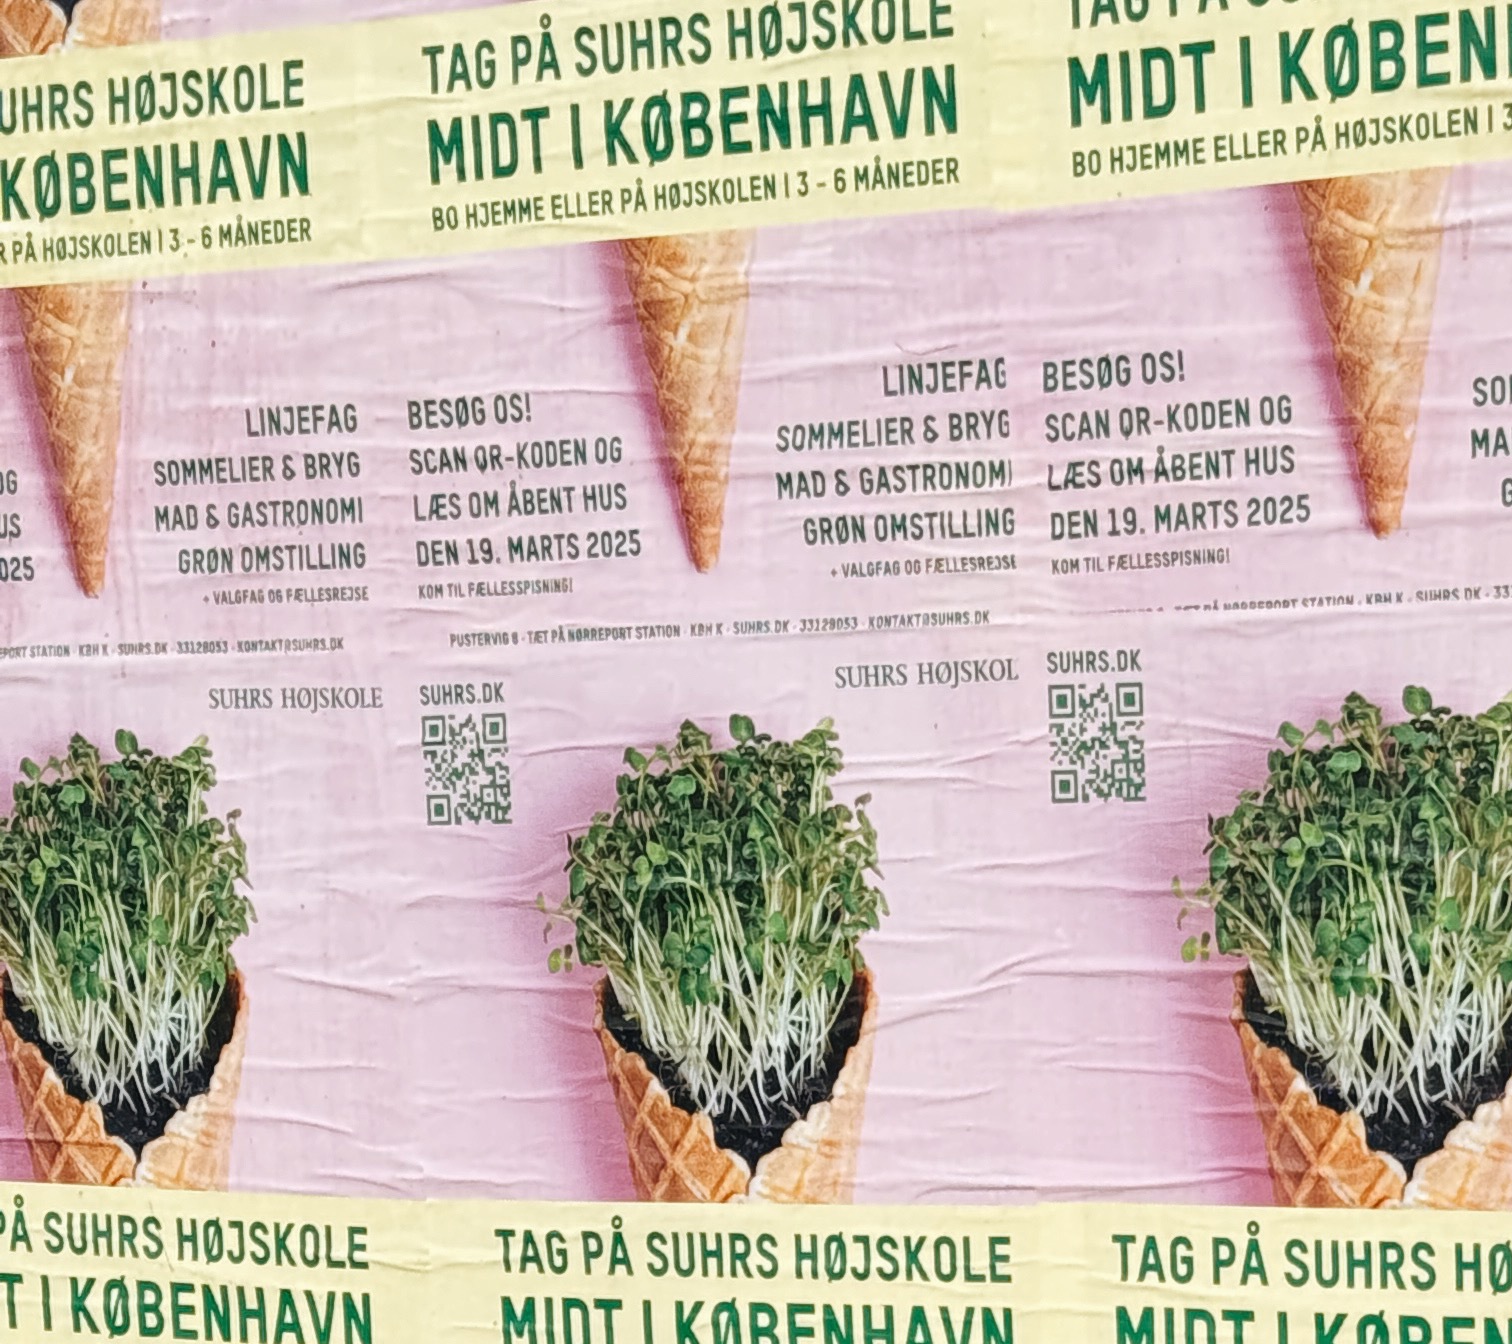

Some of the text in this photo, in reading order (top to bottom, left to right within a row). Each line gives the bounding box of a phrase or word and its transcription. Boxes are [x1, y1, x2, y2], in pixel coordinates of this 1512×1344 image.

[422, 0, 954, 94] TAG PÅ SUHRS HØJSKOLE
[108, 60, 305, 125] HØJSKOLE
[1067, 40, 1215, 128] MIDT
[1239, 36, 1253, 108] I
[427, 64, 957, 185] MIDT I KØBENHAVN
[0, 131, 309, 222] KØBENHAVN
[432, 155, 959, 232] BO HJEMME ELLER PÅ HØJSKOLEN I 3 6 MÅNEDER
[245, 404, 357, 437] LINJEFAG
[408, 392, 531, 430] BESØG OS!
[154, 452, 360, 486] SOMMELIER & BRYG
[409, 436, 621, 475] SCAN QR-KODEN OG
[414, 480, 627, 521] LÆS OM ÅBENT HUS
[416, 529, 641, 567] DEN 19. MARTS 2025
[418, 578, 573, 599] KOM TIL FÆLLESSPISNING!
[1047, 649, 1142, 674] SUHRS.DK
[209, 687, 383, 714] SUHRS HØJSKOLE
[420, 682, 504, 706] SUHRS.DK
[44, 1211, 369, 1269] SUHRS HØJSKOLE
[494, 1215, 1012, 1283] TAG PÅ SUHRS HØJSKOLE
[1112, 1234, 1194, 1284] TAG
[1212, 1221, 1268, 1286] PÅ
[1284, 1239, 1436, 1291] SUHRS
[40, 1275, 52, 1331] I
